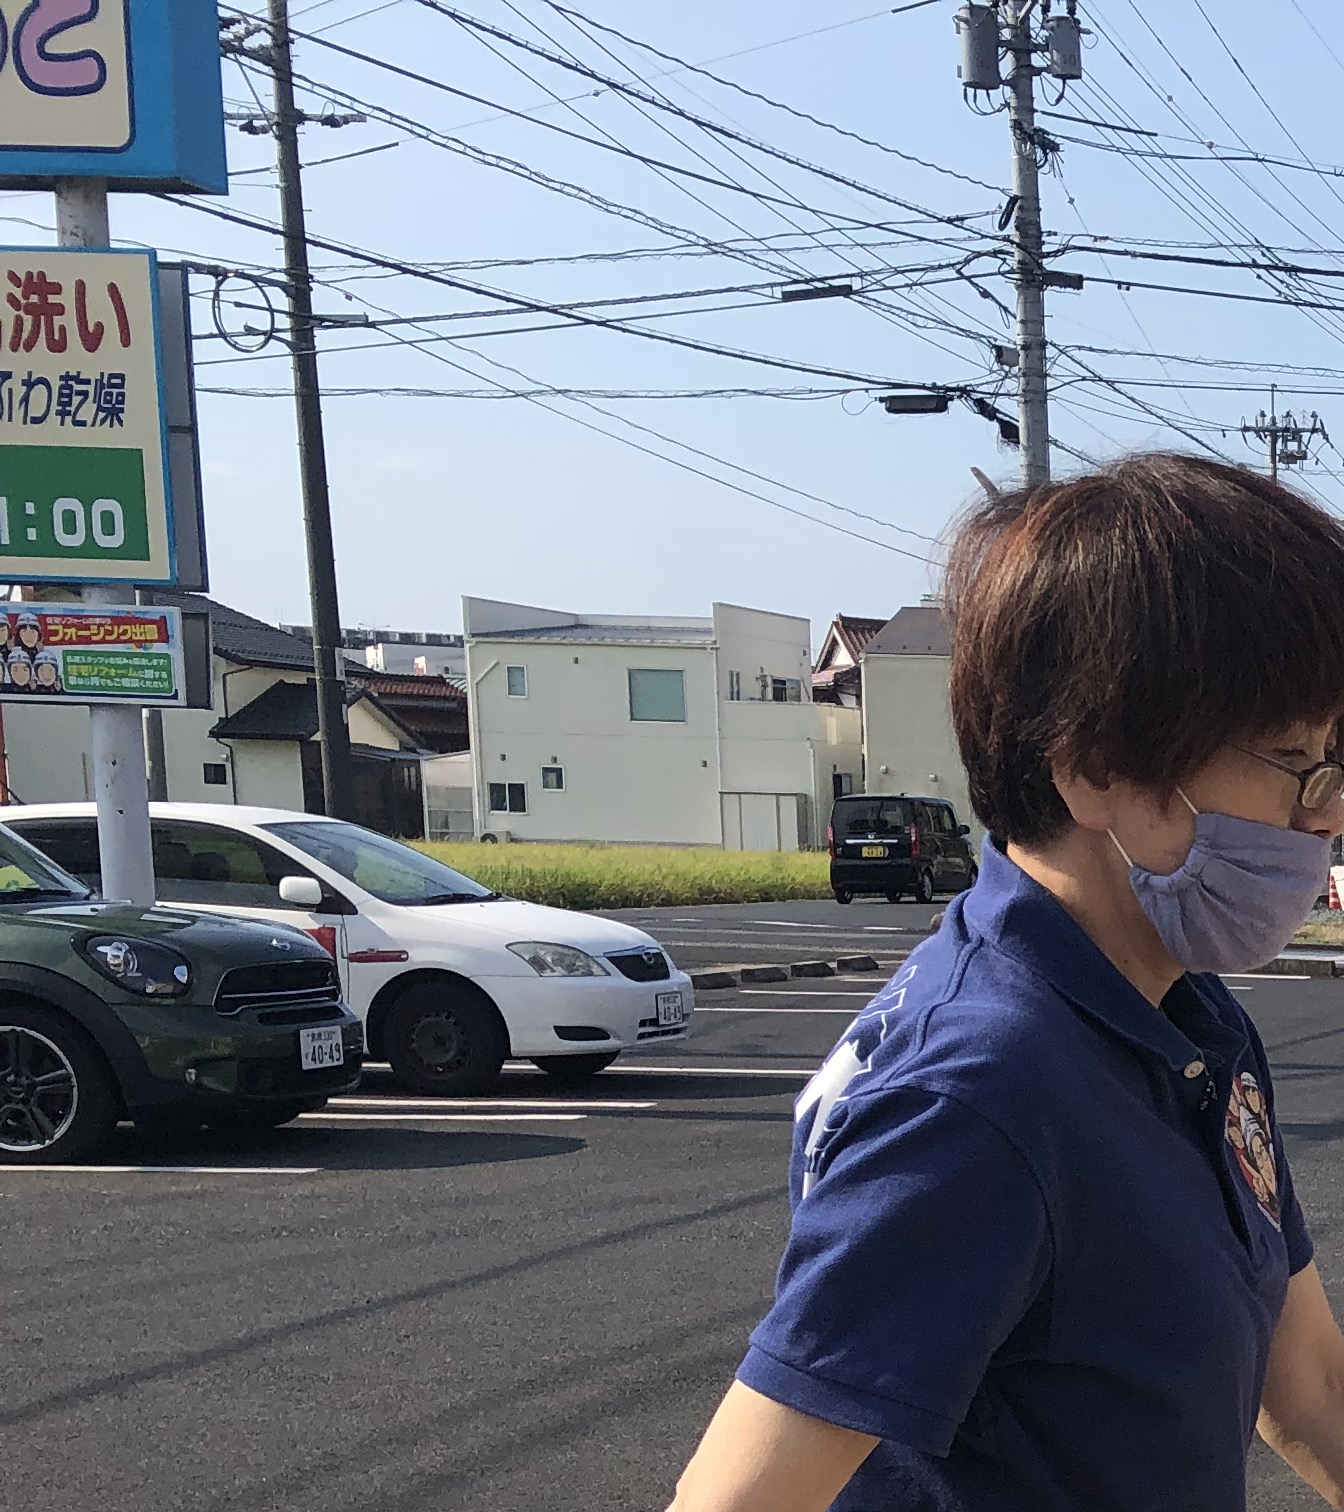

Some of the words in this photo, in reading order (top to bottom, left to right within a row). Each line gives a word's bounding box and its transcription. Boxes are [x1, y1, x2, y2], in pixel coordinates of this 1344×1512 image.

[0, 0, 107, 97] と
[0, 270, 131, 353] 洗い
[311, 1042, 341, 1064] 40-49
